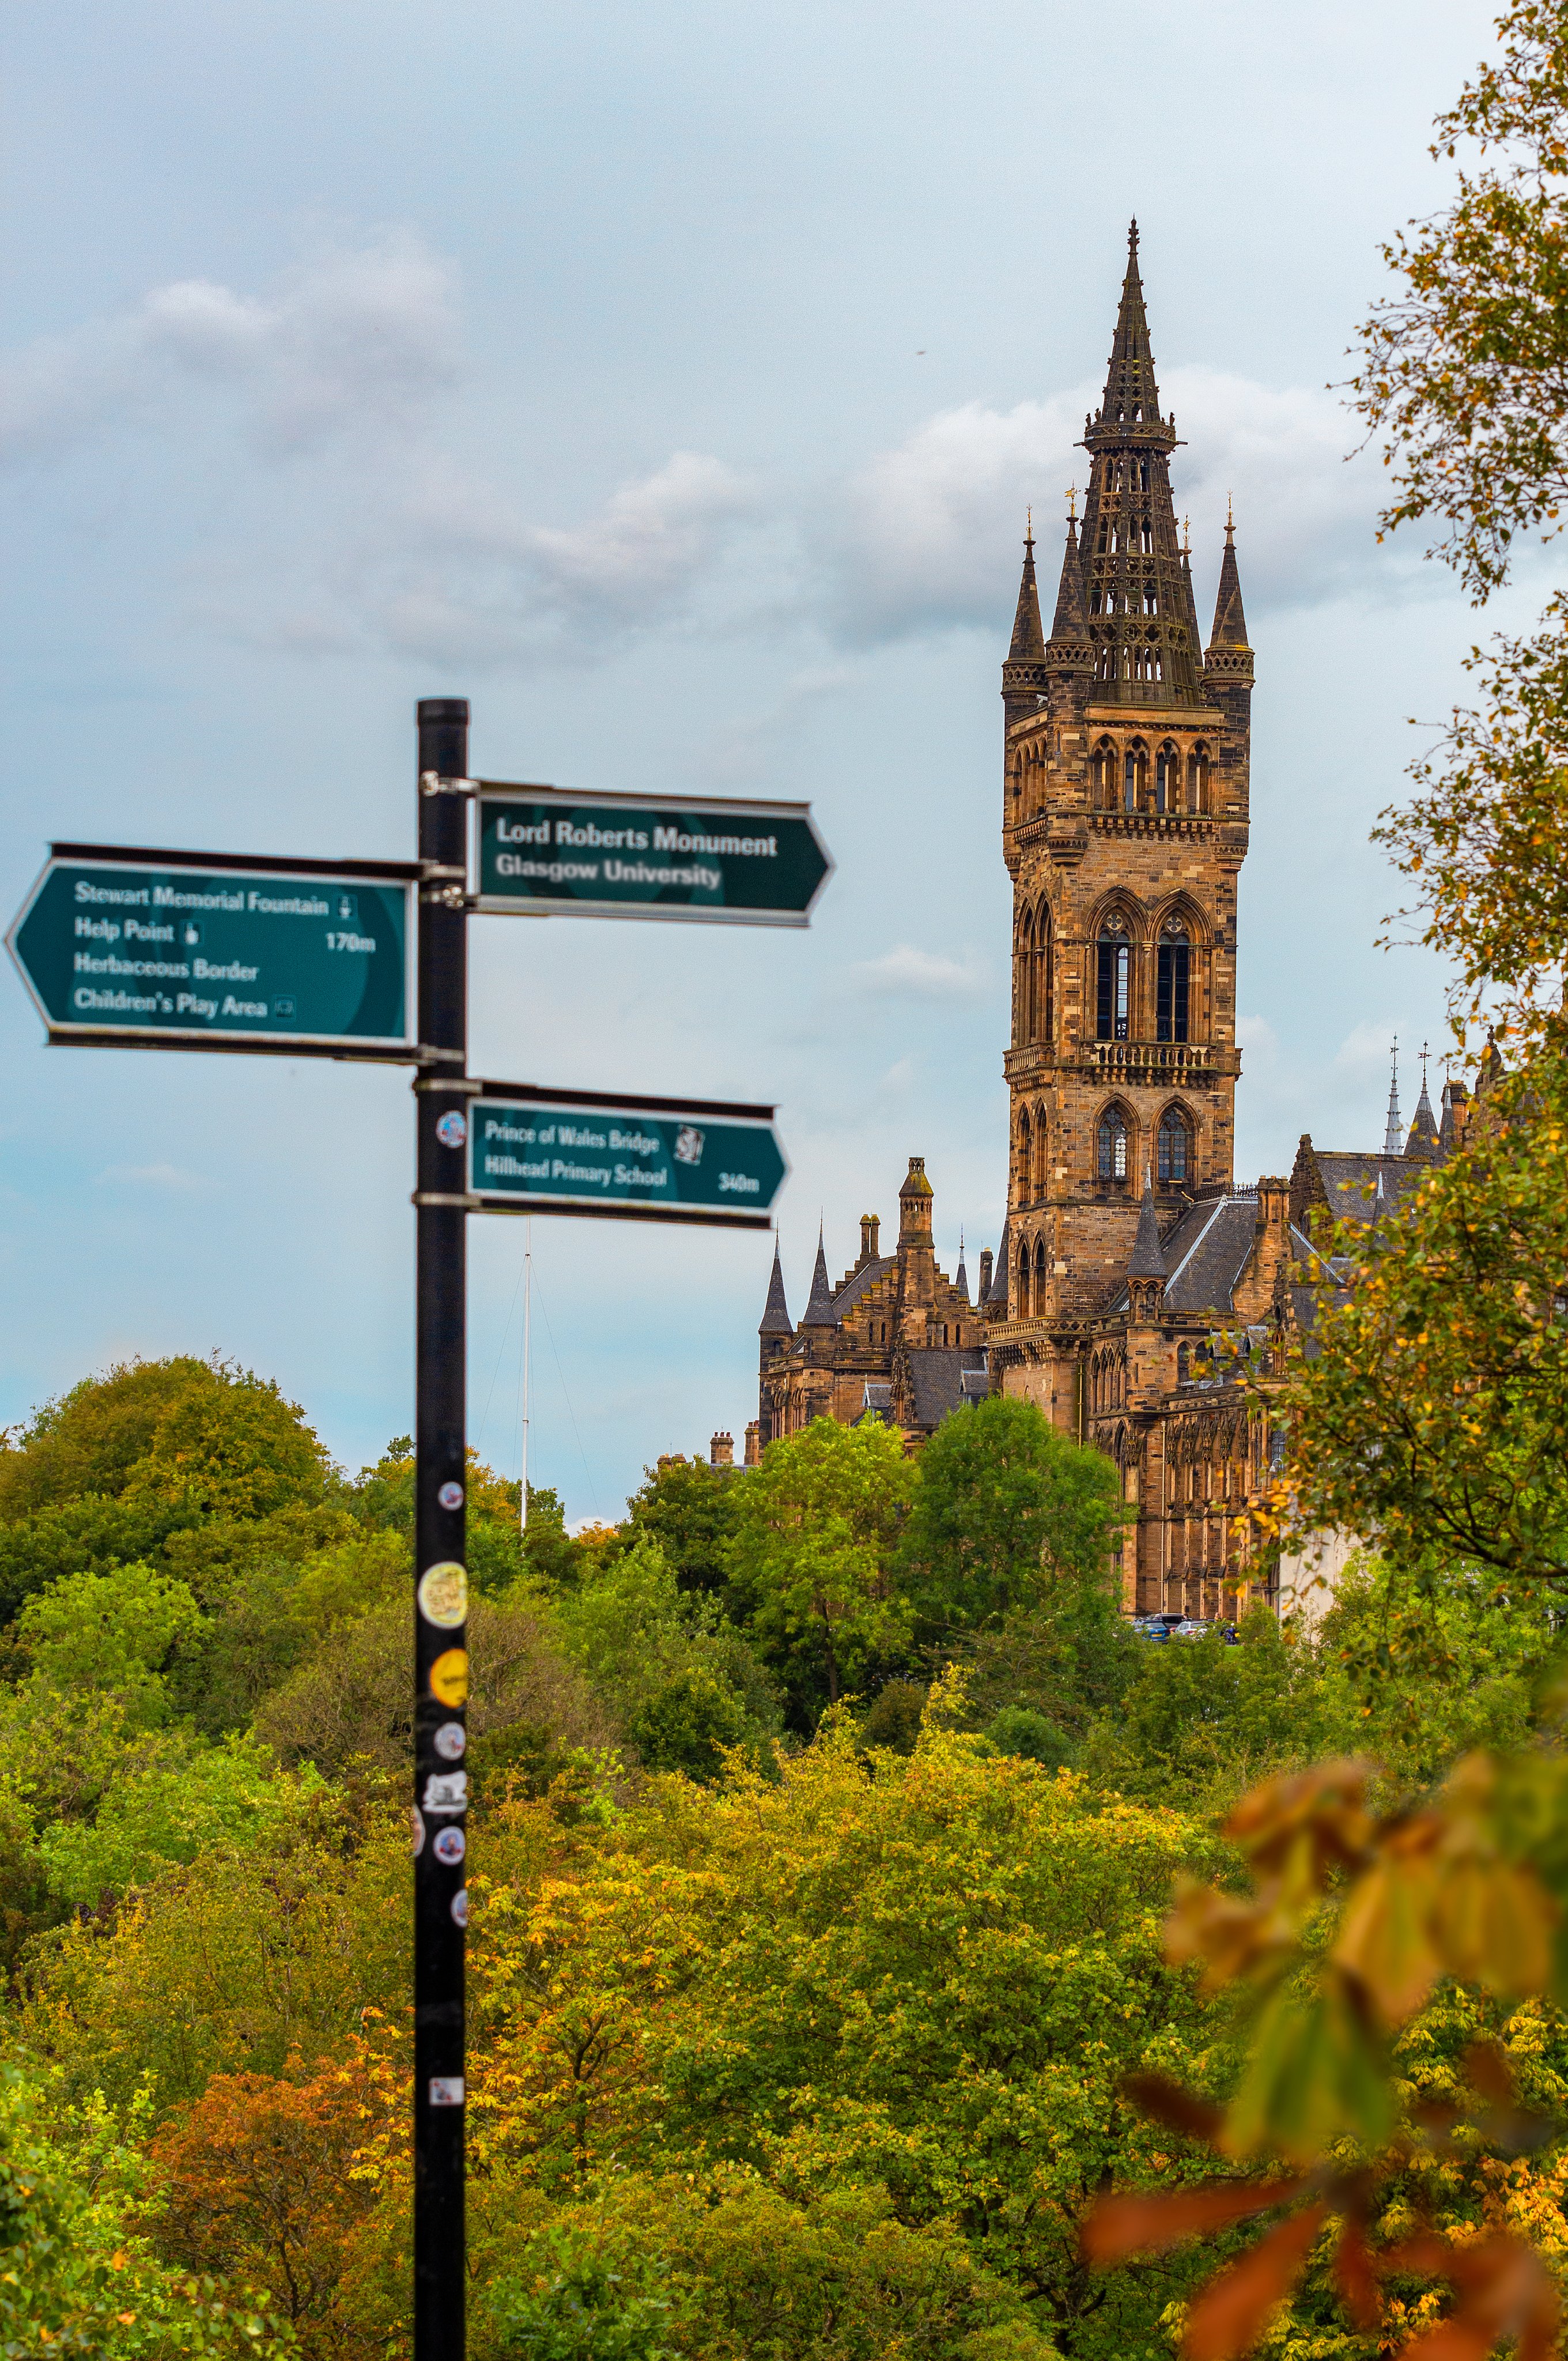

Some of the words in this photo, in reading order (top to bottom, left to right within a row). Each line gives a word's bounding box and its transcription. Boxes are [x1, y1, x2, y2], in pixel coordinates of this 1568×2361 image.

[497, 817, 550, 843] Lord
[555, 821, 648, 847] Roberts
[653, 826, 778, 857] Monument
[497, 854, 598, 882] Glasgow
[604, 859, 721, 890] University
[74, 881, 149, 906] Stewart
[152, 885, 244, 911] Memorial
[248, 892, 329, 915] Fountain
[74, 917, 119, 943] Help
[124, 919, 174, 942] Point
[326, 932, 376, 953] 170m
[74, 952, 190, 978] Herbaceous
[193, 958, 259, 981] Border
[74, 987, 173, 1013] Children's
[176, 993, 217, 1019] Play
[222, 996, 267, 1017] Area
[485, 1120, 535, 1144] Prince
[539, 1125, 557, 1144] of
[559, 1126, 606, 1149] Wales
[610, 1129, 660, 1156] Bridge
[485, 1155, 549, 1178] Hillhead
[551, 1159, 612, 1187] Primary
[615, 1164, 667, 1187] School
[719, 1172, 760, 1194] 340m
